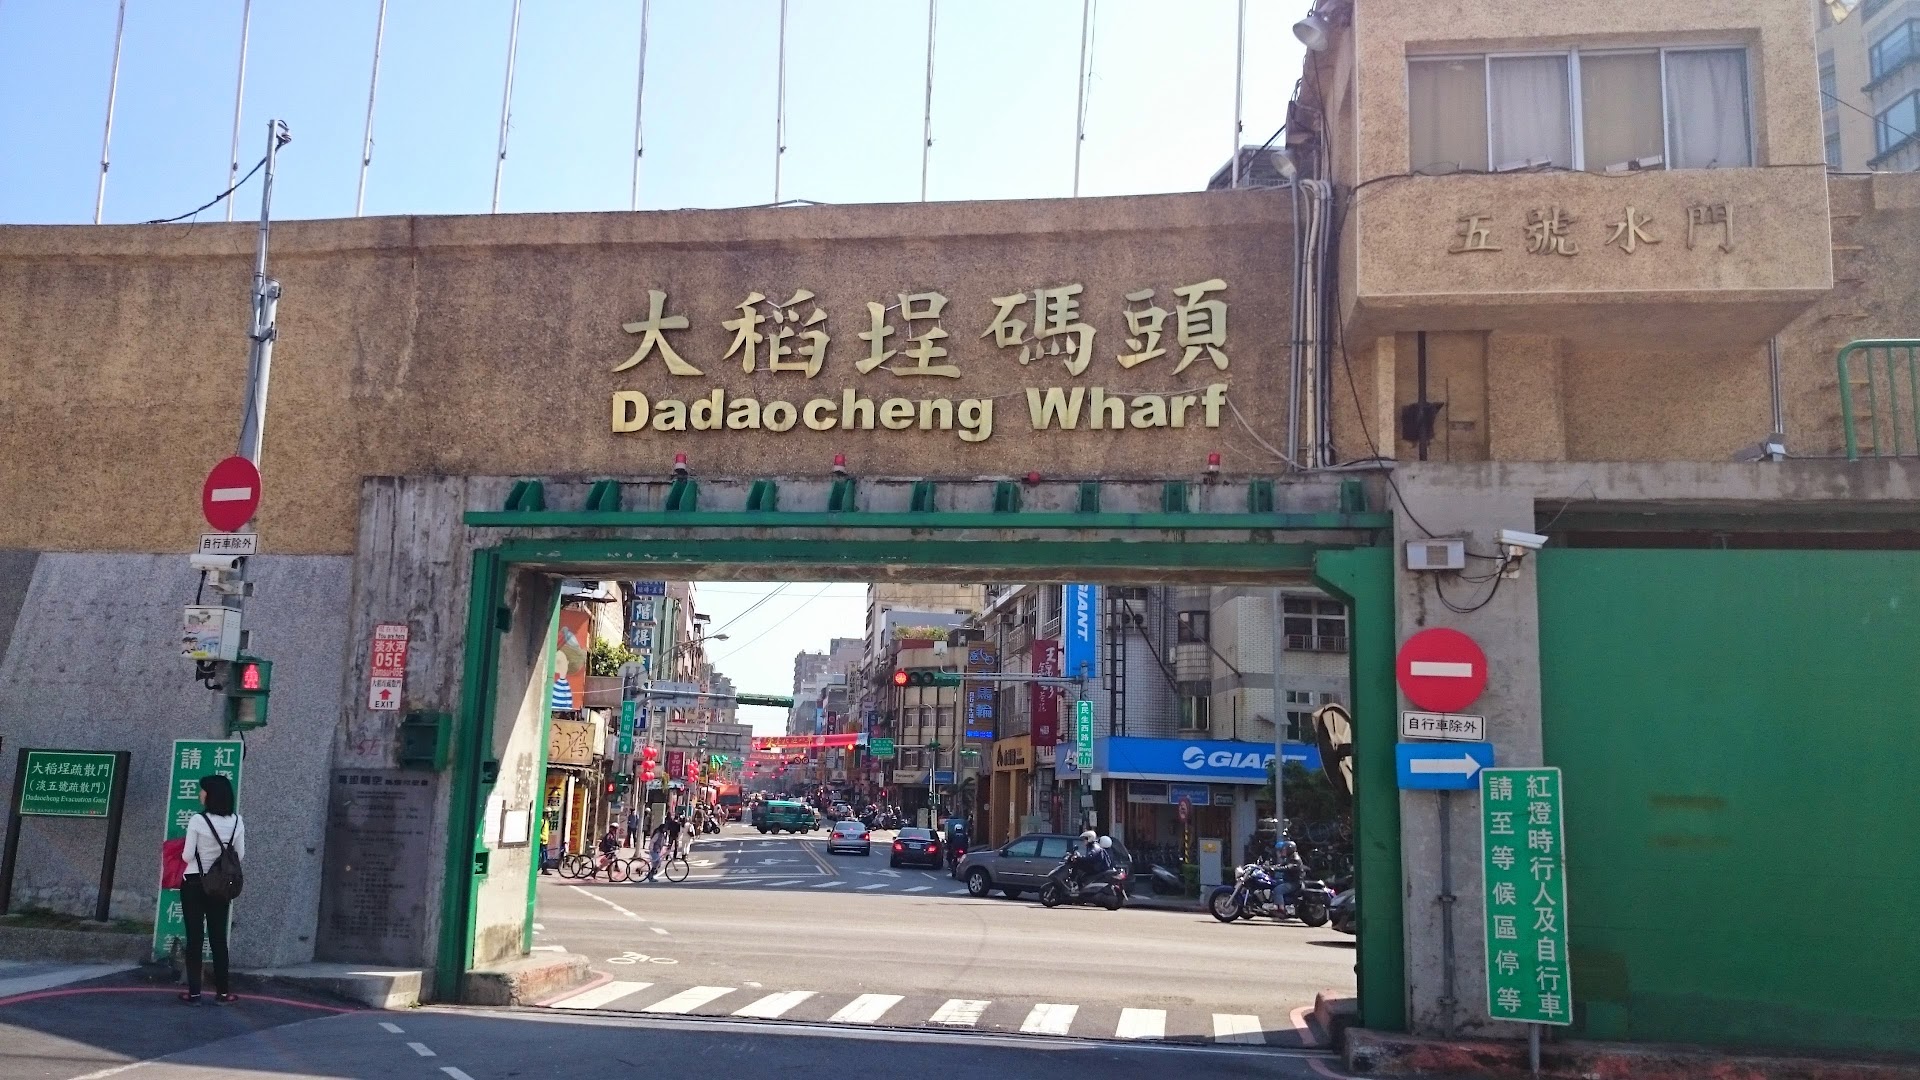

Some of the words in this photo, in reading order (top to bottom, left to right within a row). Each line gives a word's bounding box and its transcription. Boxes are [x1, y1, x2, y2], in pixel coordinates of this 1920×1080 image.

[1448, 200, 1734, 257] 五號水門
[611, 278, 1230, 379] 大稻埕碼頭
[611, 387, 993, 442] Dadaocheng
[1025, 383, 1229, 430] Wharf
[203, 538, 252, 549] 自行車除外
[374, 640, 406, 653] 淡水河
[376, 652, 402, 667] 05E
[375, 700, 394, 708] EXIT
[1081, 706, 1090, 741] 民生西路
[1408, 717, 1478, 734] 自行車除外
[31, 761, 110, 778] 大稻埕疏散門
[25, 794, 60, 803] Dadaocheng
[1489, 776, 1522, 1013] 請至等候區停等
[1525, 774, 1563, 1018] 紅燈時行人及自行車
